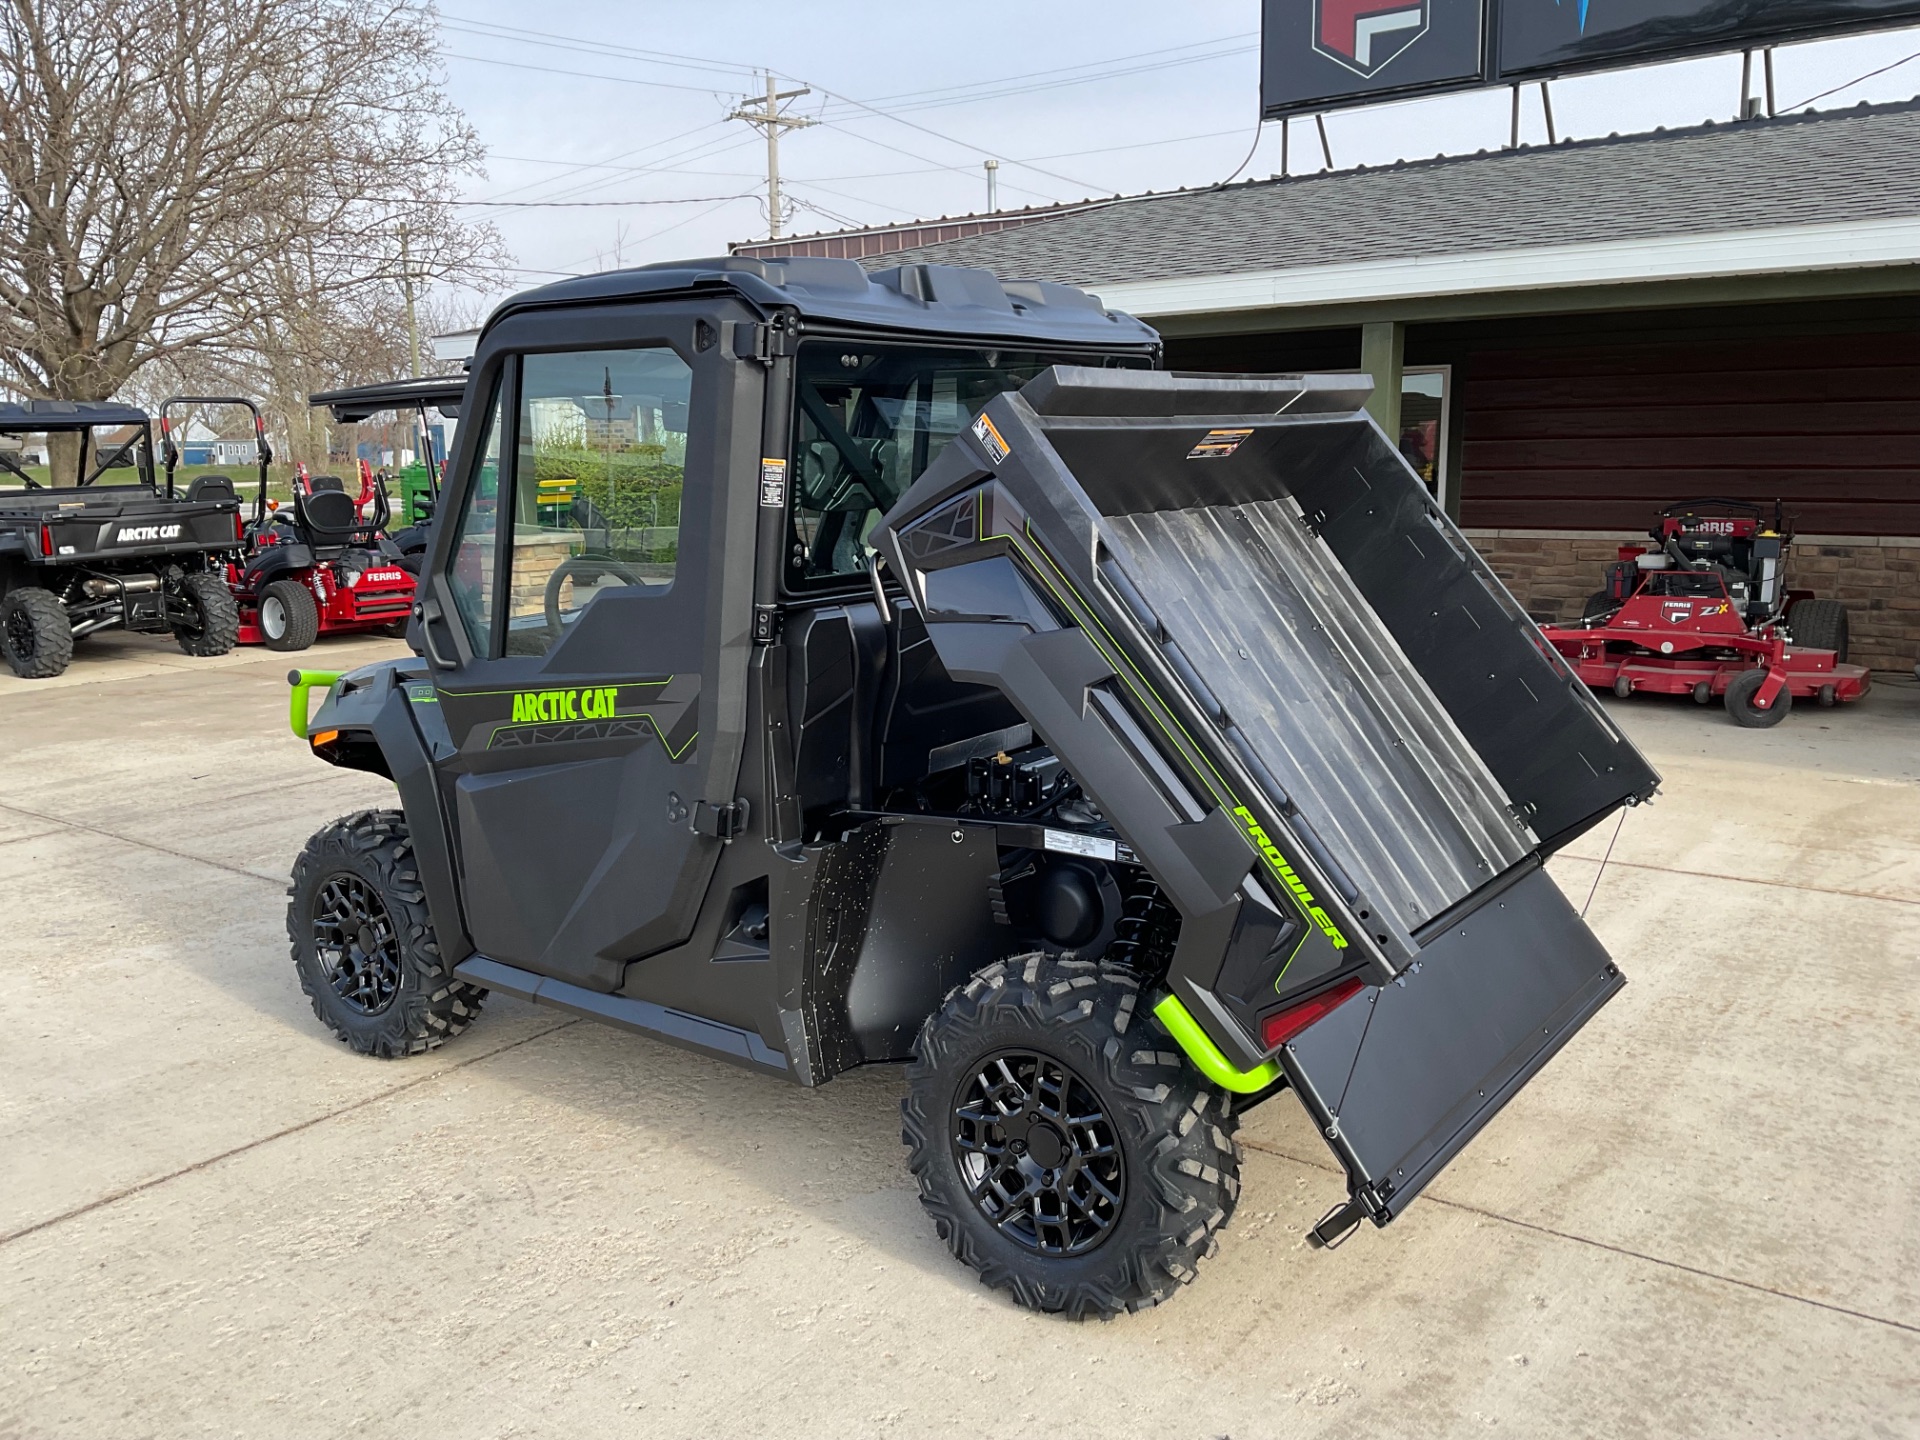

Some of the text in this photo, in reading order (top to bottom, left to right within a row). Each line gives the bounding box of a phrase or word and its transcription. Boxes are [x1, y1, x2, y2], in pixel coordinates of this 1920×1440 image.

[117, 524, 182, 542] ARCTIC CAT
[1682, 522, 1734, 532] RRIS
[367, 571, 402, 582] FERRIS
[512, 688, 618, 722] ARCTIC CAT
[1233, 805, 1349, 950] PROWLER
